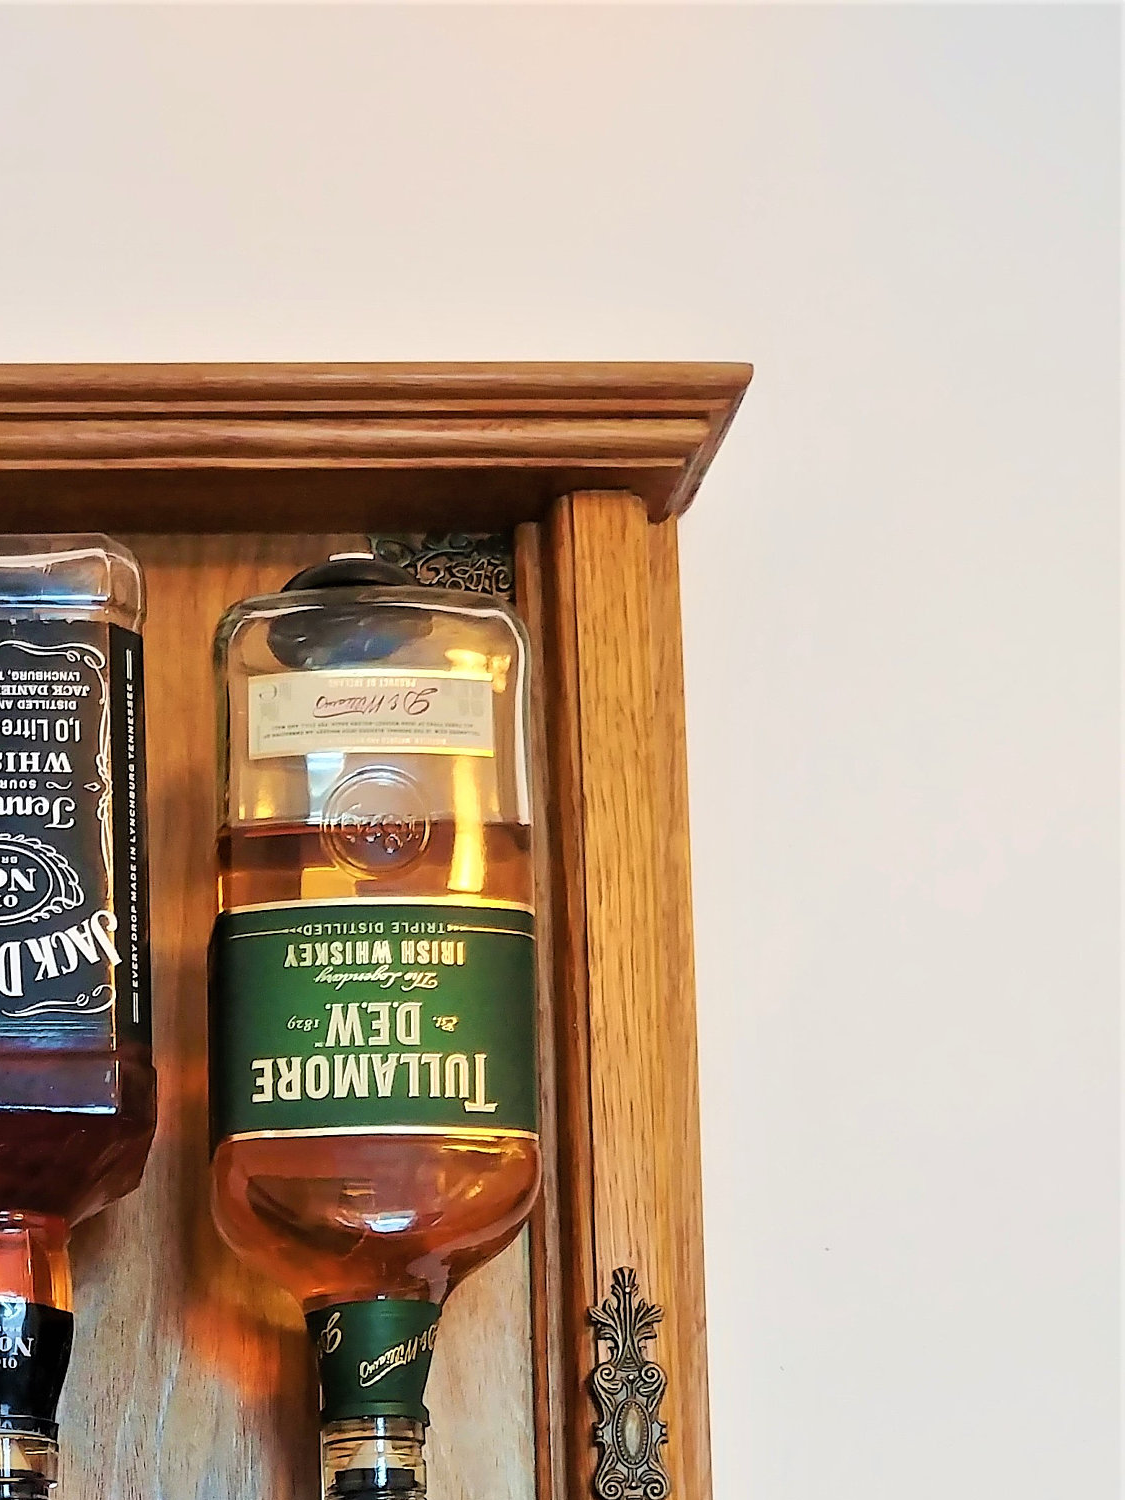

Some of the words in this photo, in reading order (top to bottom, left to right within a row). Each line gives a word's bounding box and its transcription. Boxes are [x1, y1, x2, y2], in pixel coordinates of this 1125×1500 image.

[7, 669, 81, 681] LYNCHBURG,
[51, 684, 91, 697] JACK
[17, 699, 77, 711] DISTILLED
[1, 718, 49, 742] Litre
[55, 717, 81, 742] 1,0
[126, 683, 136, 760] TENNESSEE
[0, 779, 37, 790] SOUR
[128, 764, 136, 843] LYNCHBURG
[129, 846, 137, 861] IN
[129, 863, 138, 902] MADE
[130, 905, 138, 941] DROP
[302, 922, 384, 936] DISTILLED
[390, 921, 445, 934] TRIPLE
[24, 910, 122, 982] JACK
[283, 939, 393, 968] WHISKEY
[400, 939, 466, 966] IRISH
[130, 944, 139, 988] EVERY
[313, 964, 402, 991] Legendary
[401, 971, 438, 992] The
[287, 1015, 320, 1031] 1829
[324, 1001, 423, 1047] D.E.W.
[432, 1015, 458, 1032] Est.
[250, 1051, 498, 1114] TULLAMORE
